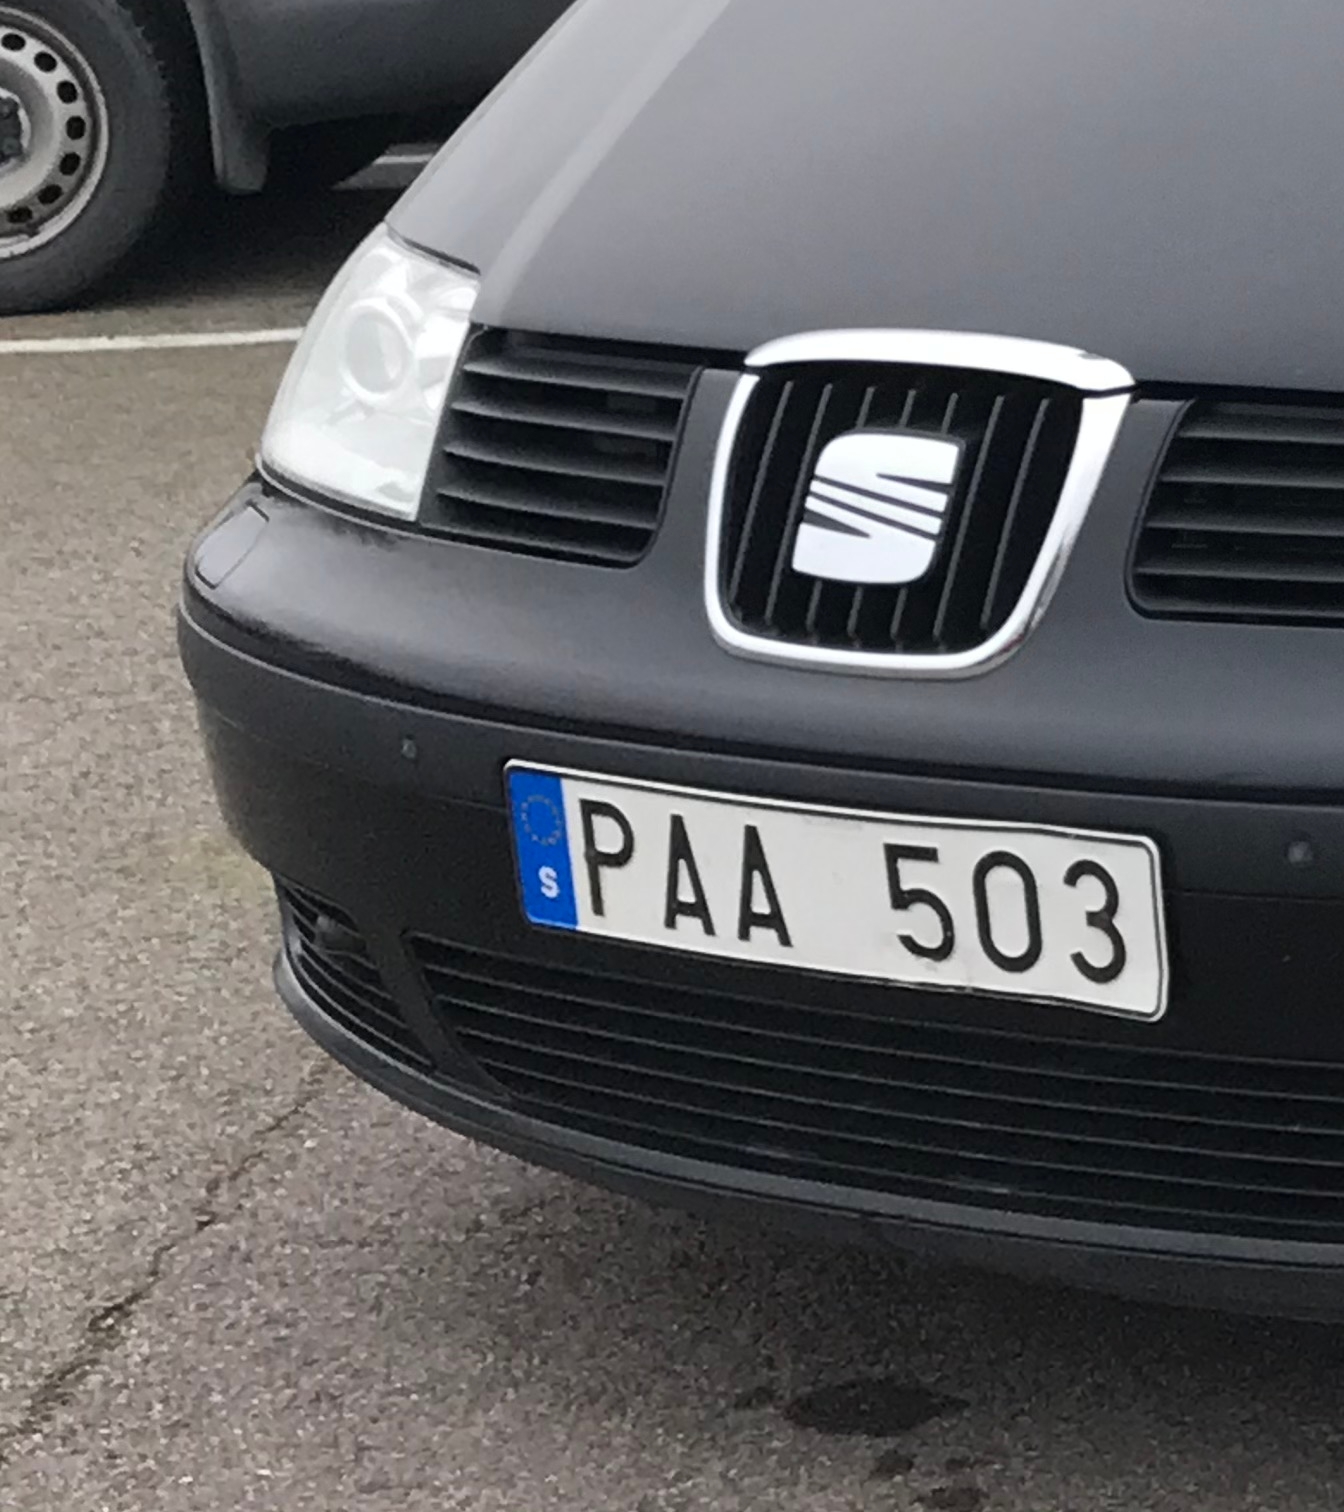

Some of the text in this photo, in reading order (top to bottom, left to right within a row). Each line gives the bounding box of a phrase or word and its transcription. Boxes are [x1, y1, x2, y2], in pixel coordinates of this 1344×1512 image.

[538, 797, 1128, 985] S PAA 503
